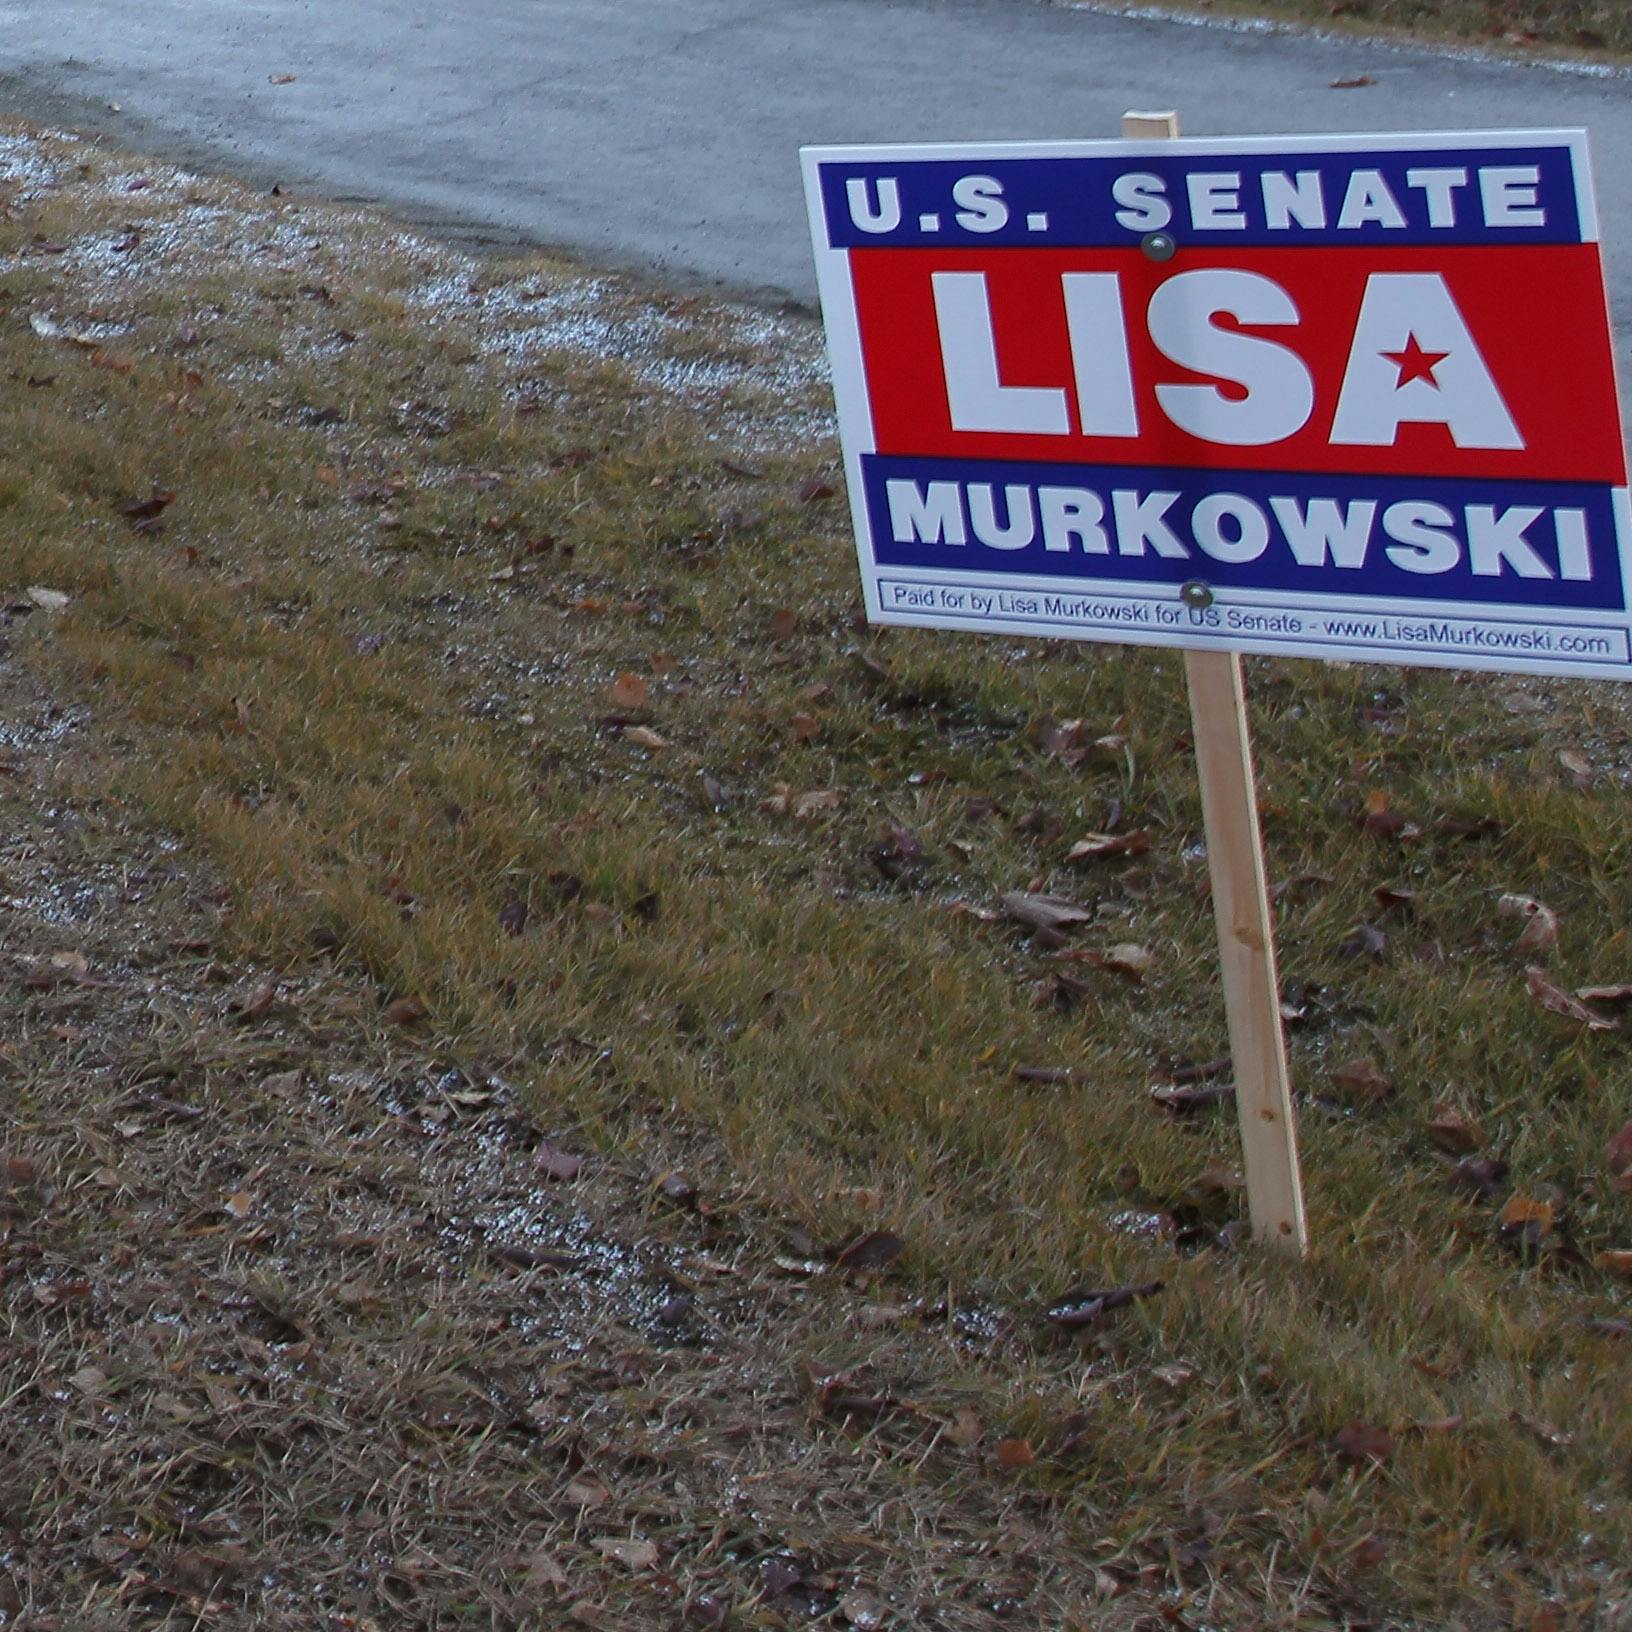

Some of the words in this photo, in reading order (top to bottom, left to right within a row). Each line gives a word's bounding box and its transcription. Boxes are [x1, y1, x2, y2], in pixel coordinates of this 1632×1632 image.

[845, 174, 1051, 235] U.S.
[1112, 165, 1547, 232] SENATE
[931, 267, 1527, 452] LISA
[885, 478, 1595, 582] MURKOWSKI
[894, 586, 935, 607] Paid
[940, 589, 964, 609] for
[970, 590, 993, 615] by
[999, 593, 1037, 614] Lisa
[1045, 597, 1150, 623] Murkowski
[1155, 603, 1180, 624] for
[1188, 606, 1220, 627] US
[1228, 609, 1302, 634] Senate
[1323, 619, 1612, 655] www.LisaMurkowski.com
